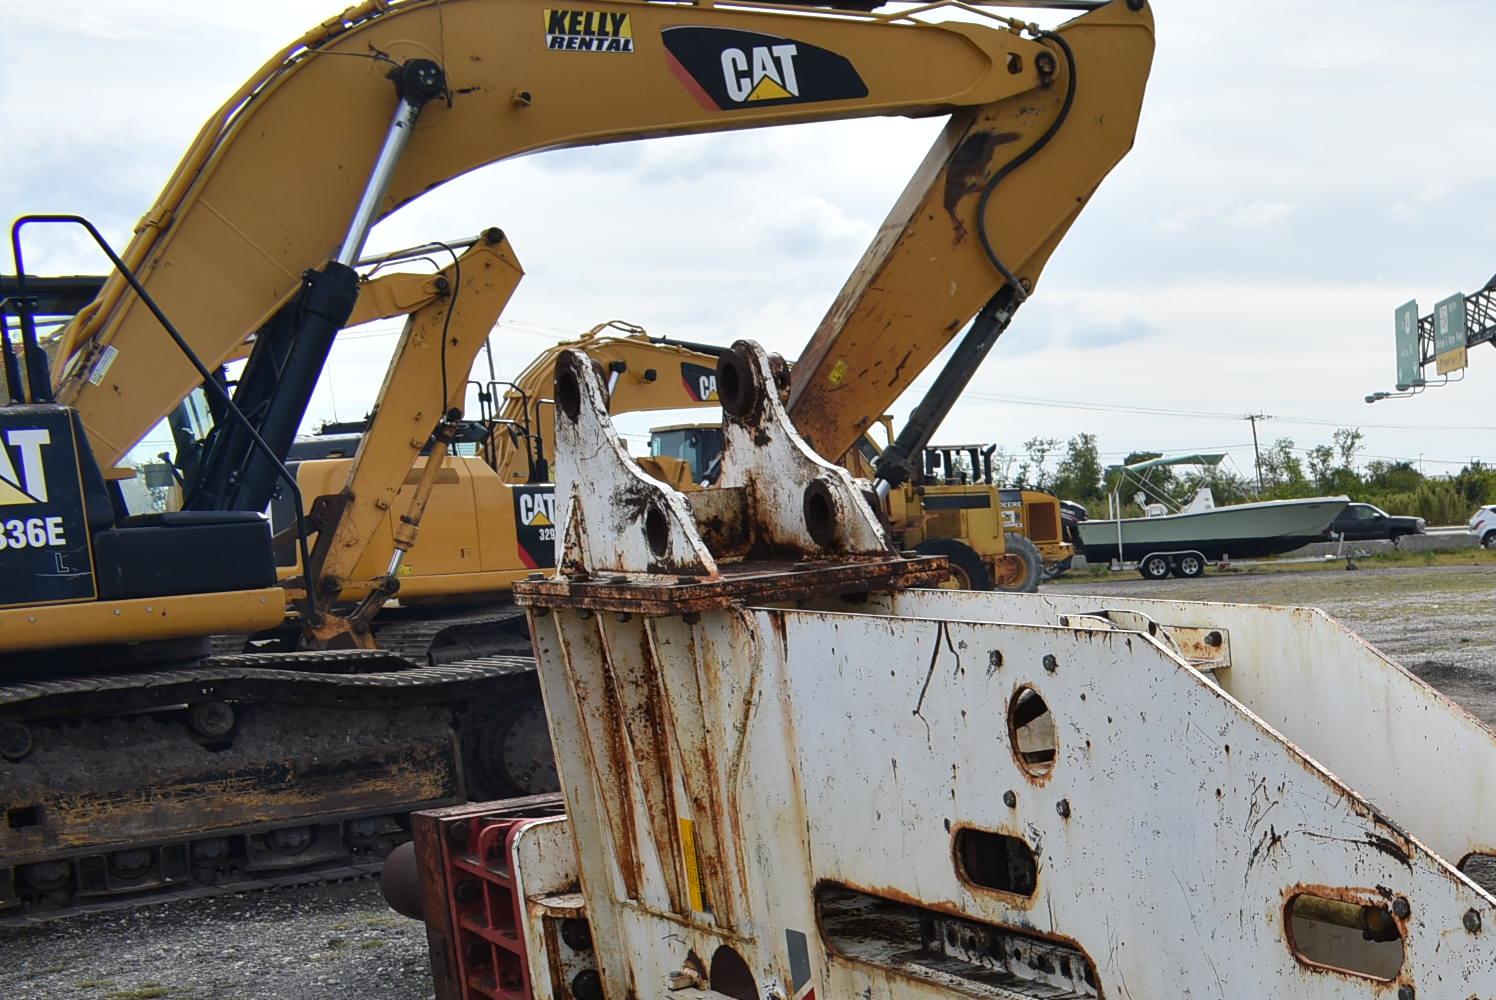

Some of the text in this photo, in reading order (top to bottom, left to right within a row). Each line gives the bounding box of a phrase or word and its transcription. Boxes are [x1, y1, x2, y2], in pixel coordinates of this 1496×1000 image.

[547, 10, 627, 36] KELLY
[549, 36, 632, 52] RENTAL
[720, 44, 799, 102] CAT
[699, 375, 717, 400] CA
[520, 493, 555, 526] CAT
